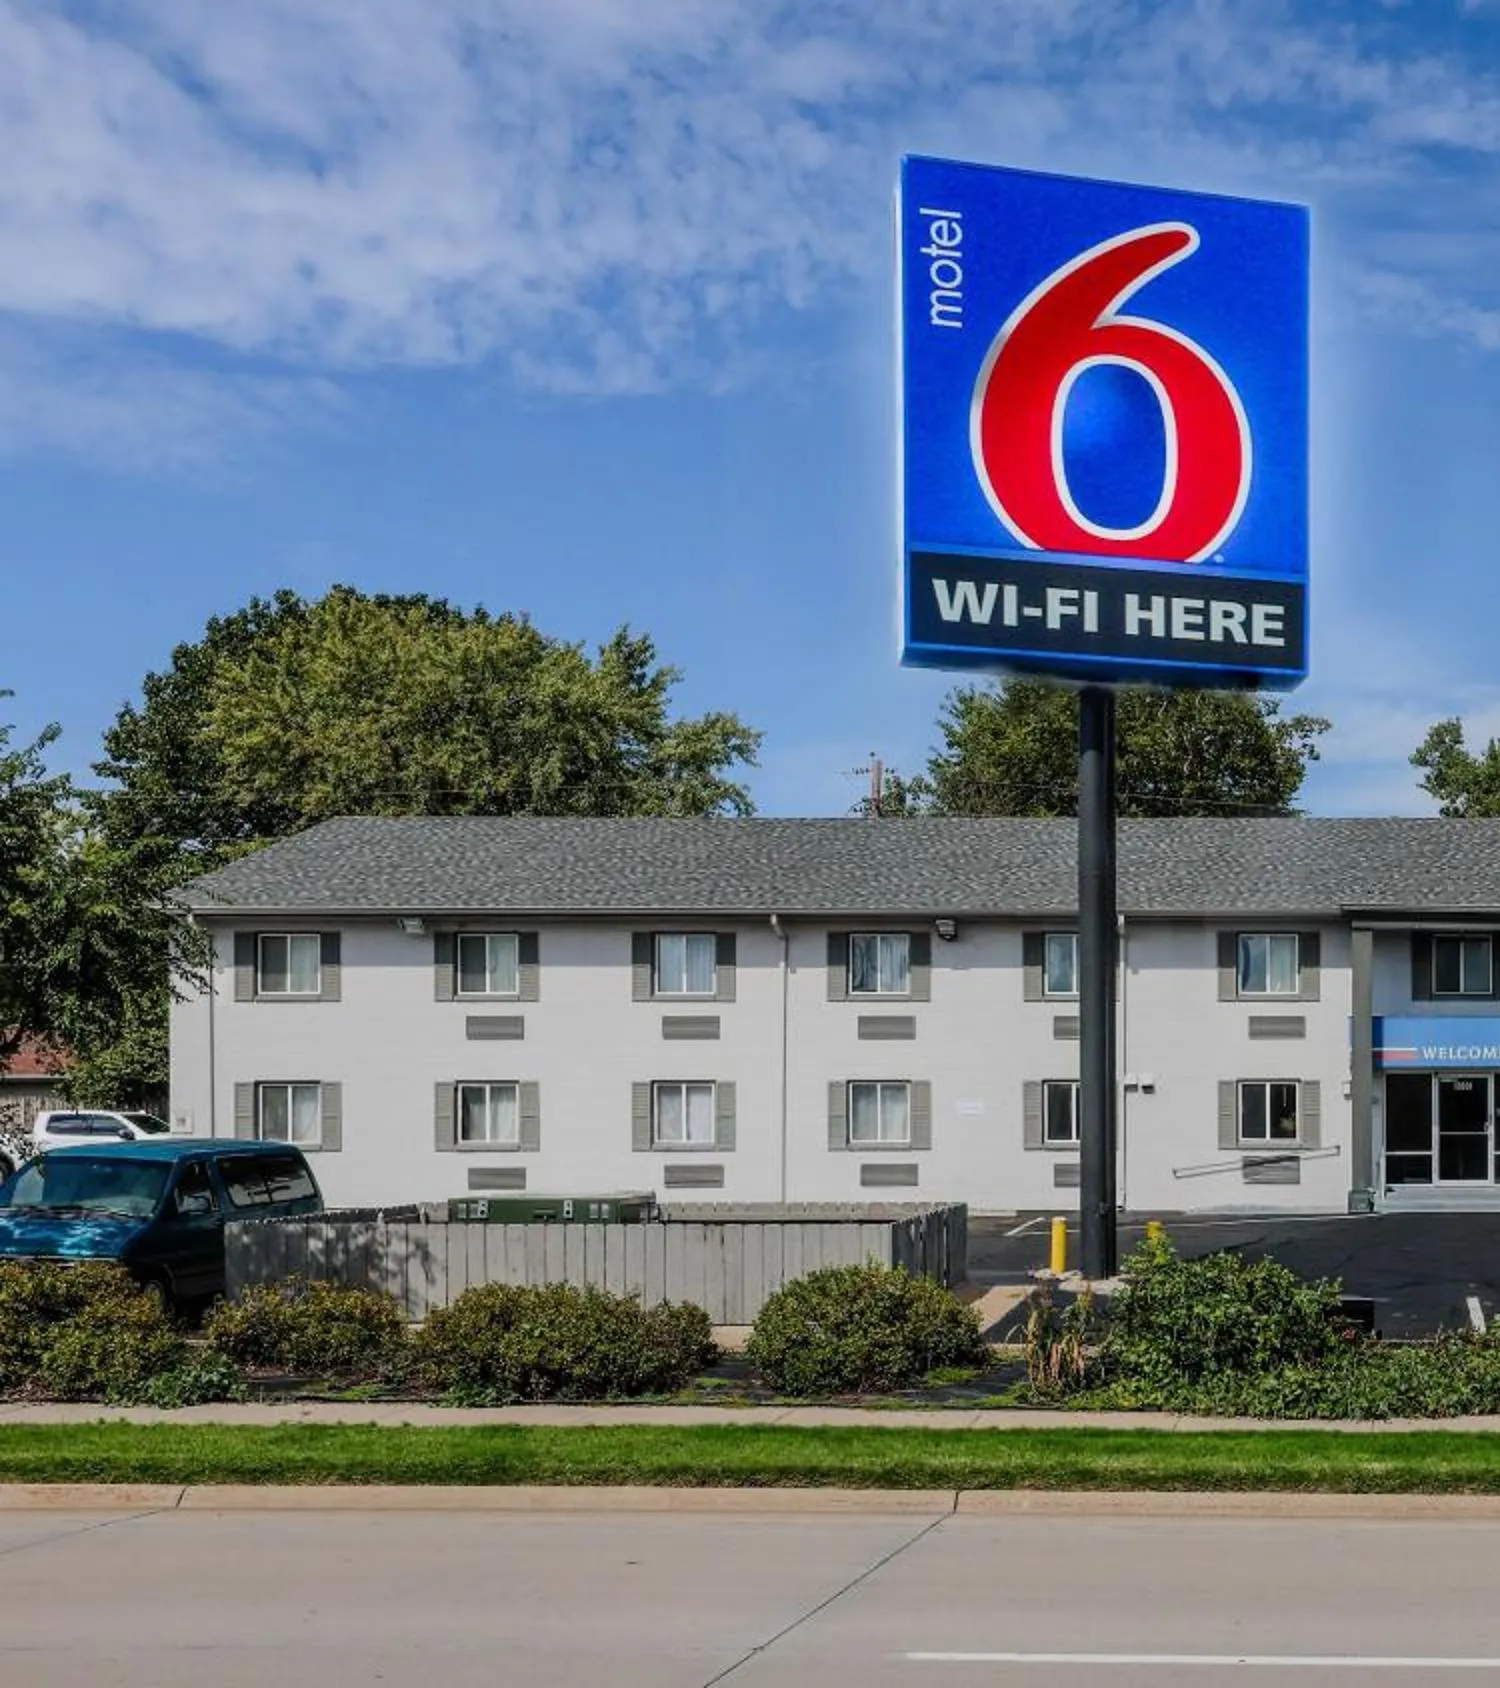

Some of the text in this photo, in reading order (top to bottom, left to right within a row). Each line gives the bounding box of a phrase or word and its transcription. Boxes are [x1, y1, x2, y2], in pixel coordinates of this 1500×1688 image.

[919, 207, 963, 329] motel
[969, 221, 1253, 564] 6
[931, 578, 1286, 647] WI-FI HERE
